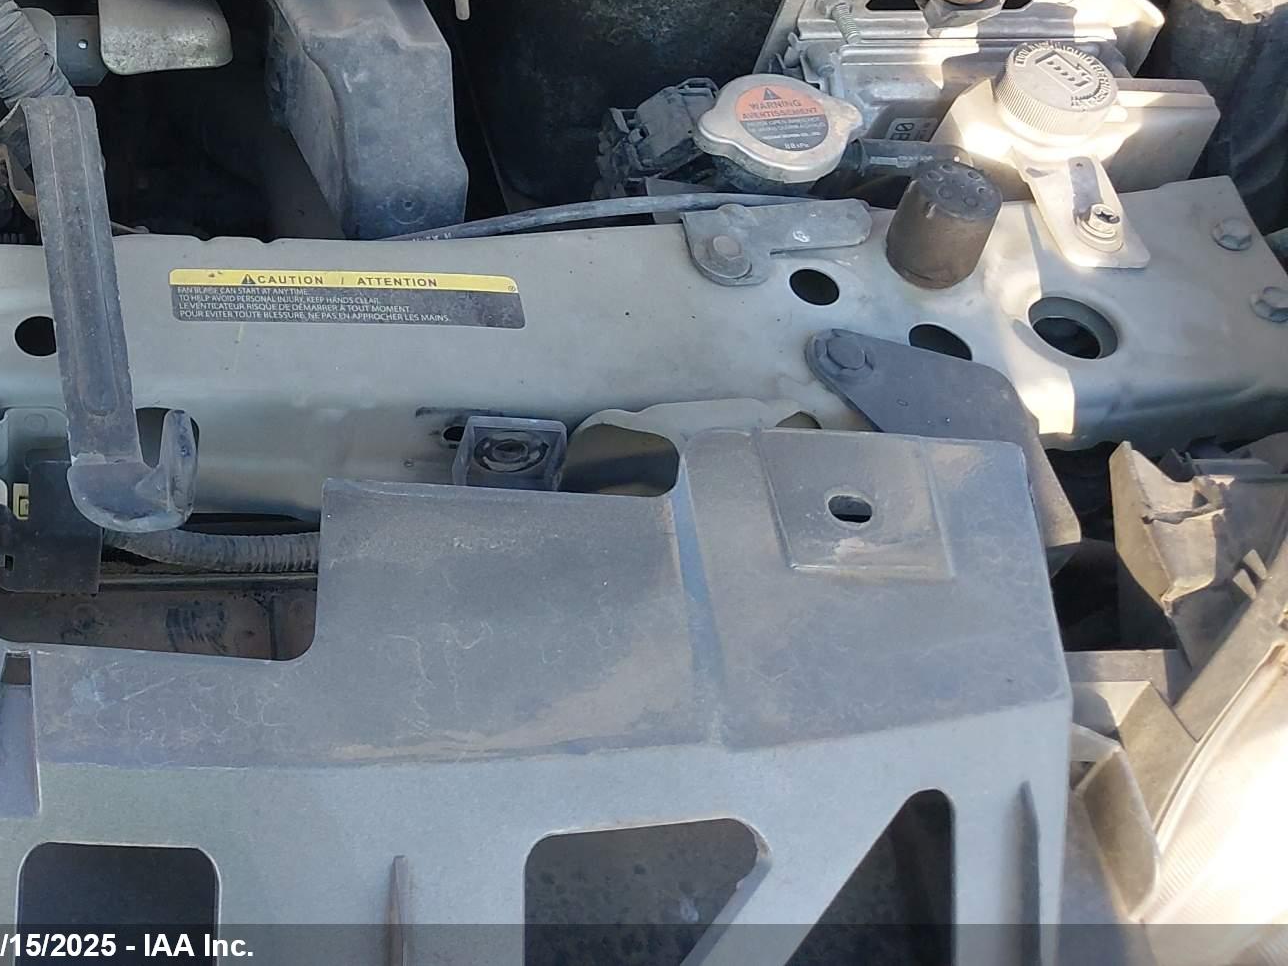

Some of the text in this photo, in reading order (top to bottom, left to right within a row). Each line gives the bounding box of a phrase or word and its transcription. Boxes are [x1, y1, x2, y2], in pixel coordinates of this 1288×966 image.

[749, 99, 802, 110] WARNING
[742, 107, 818, 120] AVERTISSEMENT
[257, 275, 323, 285] CAUTION
[357, 277, 437, 287] ATTENTION
[194, 287, 218, 295] BLAE
[220, 287, 237, 295] CAN
[272, 288, 289, 296] ANY
[211, 295, 236, 303] AVOID
[237, 295, 277, 304] PERSONAL
[326, 297, 354, 305] HANDS
[190, 303, 245, 311] VENTILATEUR
[246, 303, 278, 311] RISQUE
[180, 310, 204, 318] POUR
[234, 311, 263, 319] TOUTE
[321, 312, 337, 320] PAS
[351, 312, 403, 321] APPROCHER
[404, 313, 419, 321] LES
